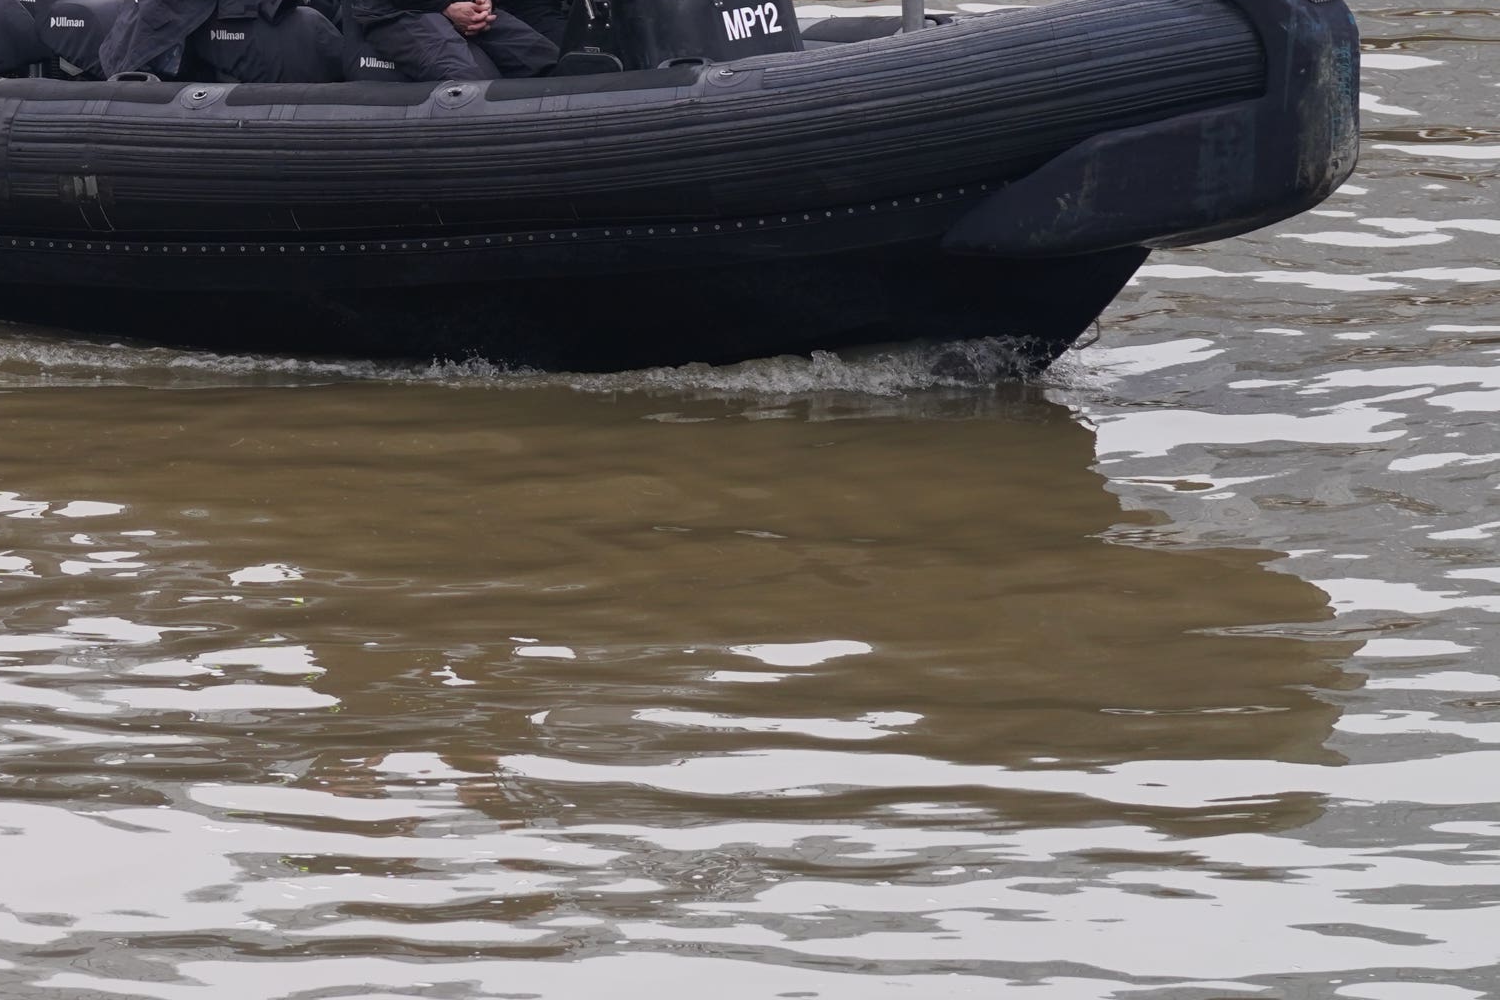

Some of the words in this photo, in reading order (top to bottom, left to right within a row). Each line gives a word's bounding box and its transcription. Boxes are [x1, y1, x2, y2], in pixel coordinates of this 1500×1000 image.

[56, 17, 85, 28] Ullman
[722, 2, 783, 41] MP12
[216, 29, 245, 40] Ullman
[365, 57, 395, 69] Ullman
